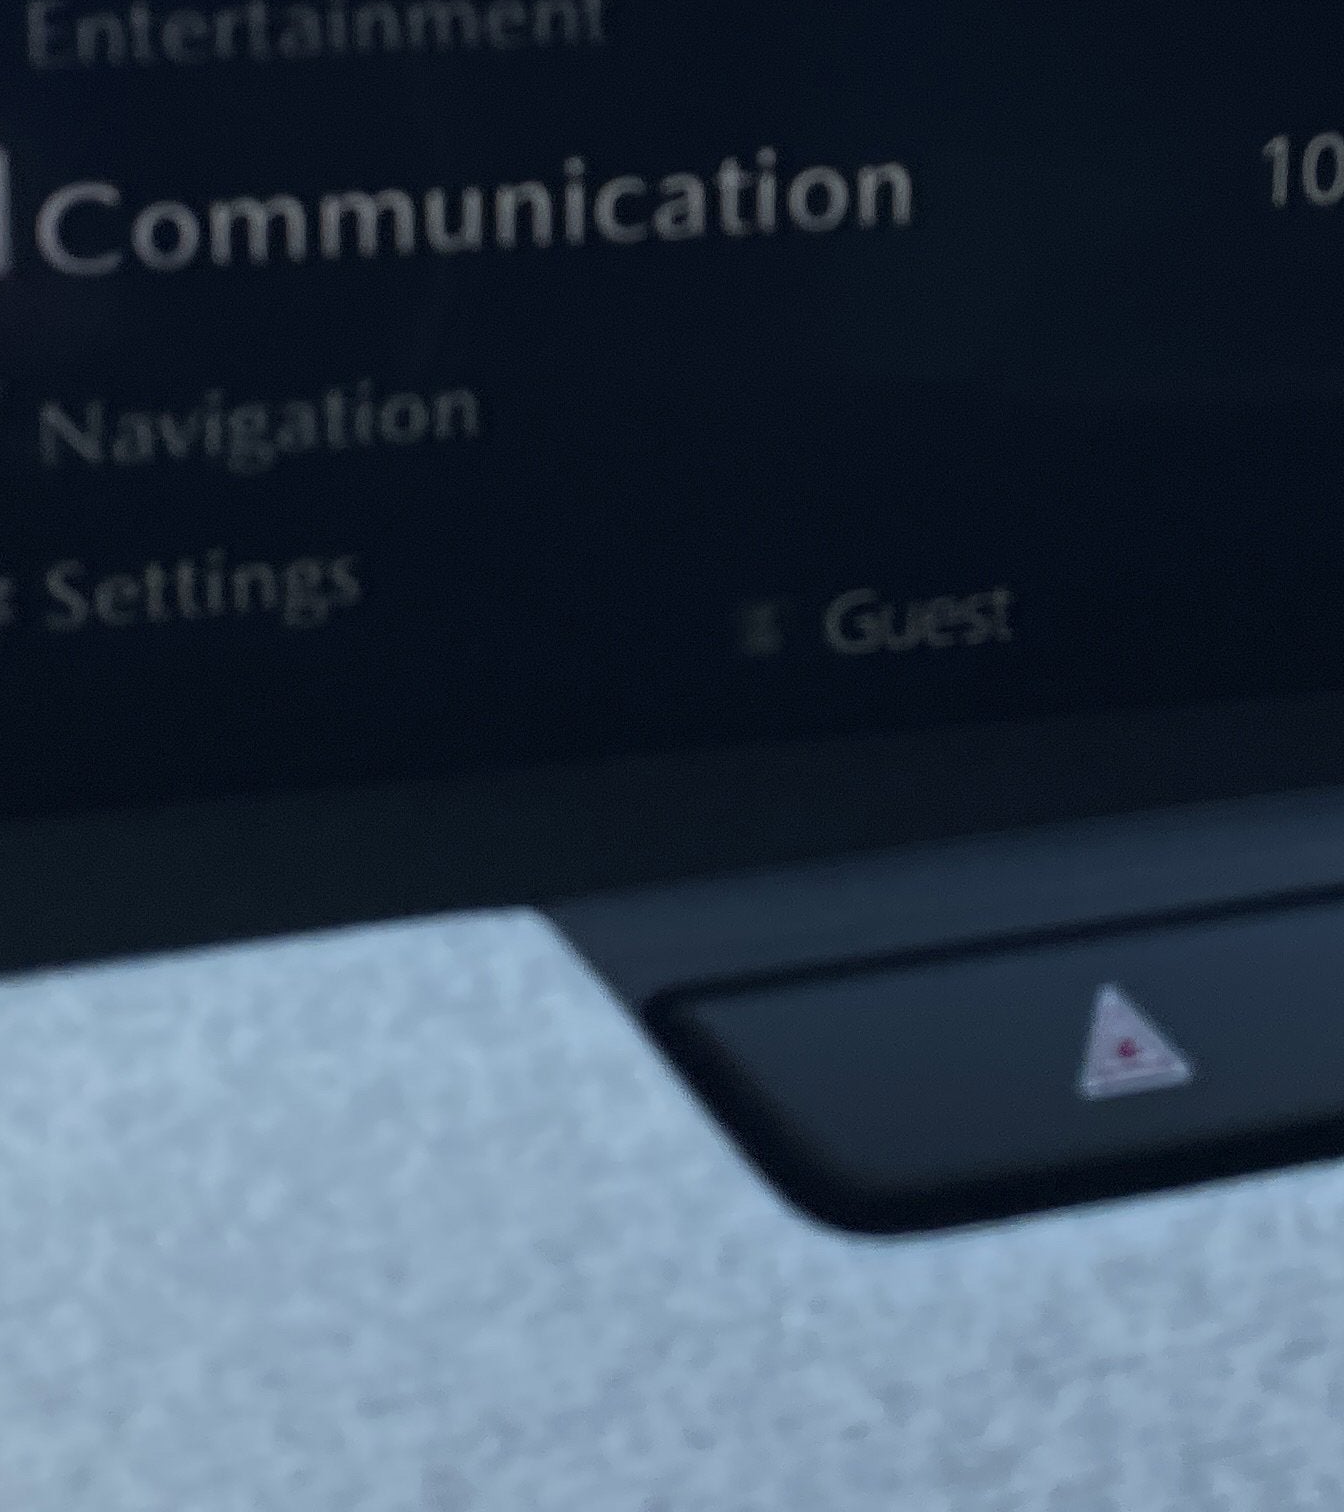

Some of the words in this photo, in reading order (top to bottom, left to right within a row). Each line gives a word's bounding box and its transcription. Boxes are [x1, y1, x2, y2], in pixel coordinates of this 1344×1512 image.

[34, 144, 916, 276] Communication
[36, 379, 484, 478] Navigation
[43, 544, 363, 634] Settings
[820, 584, 1017, 659] Guest
